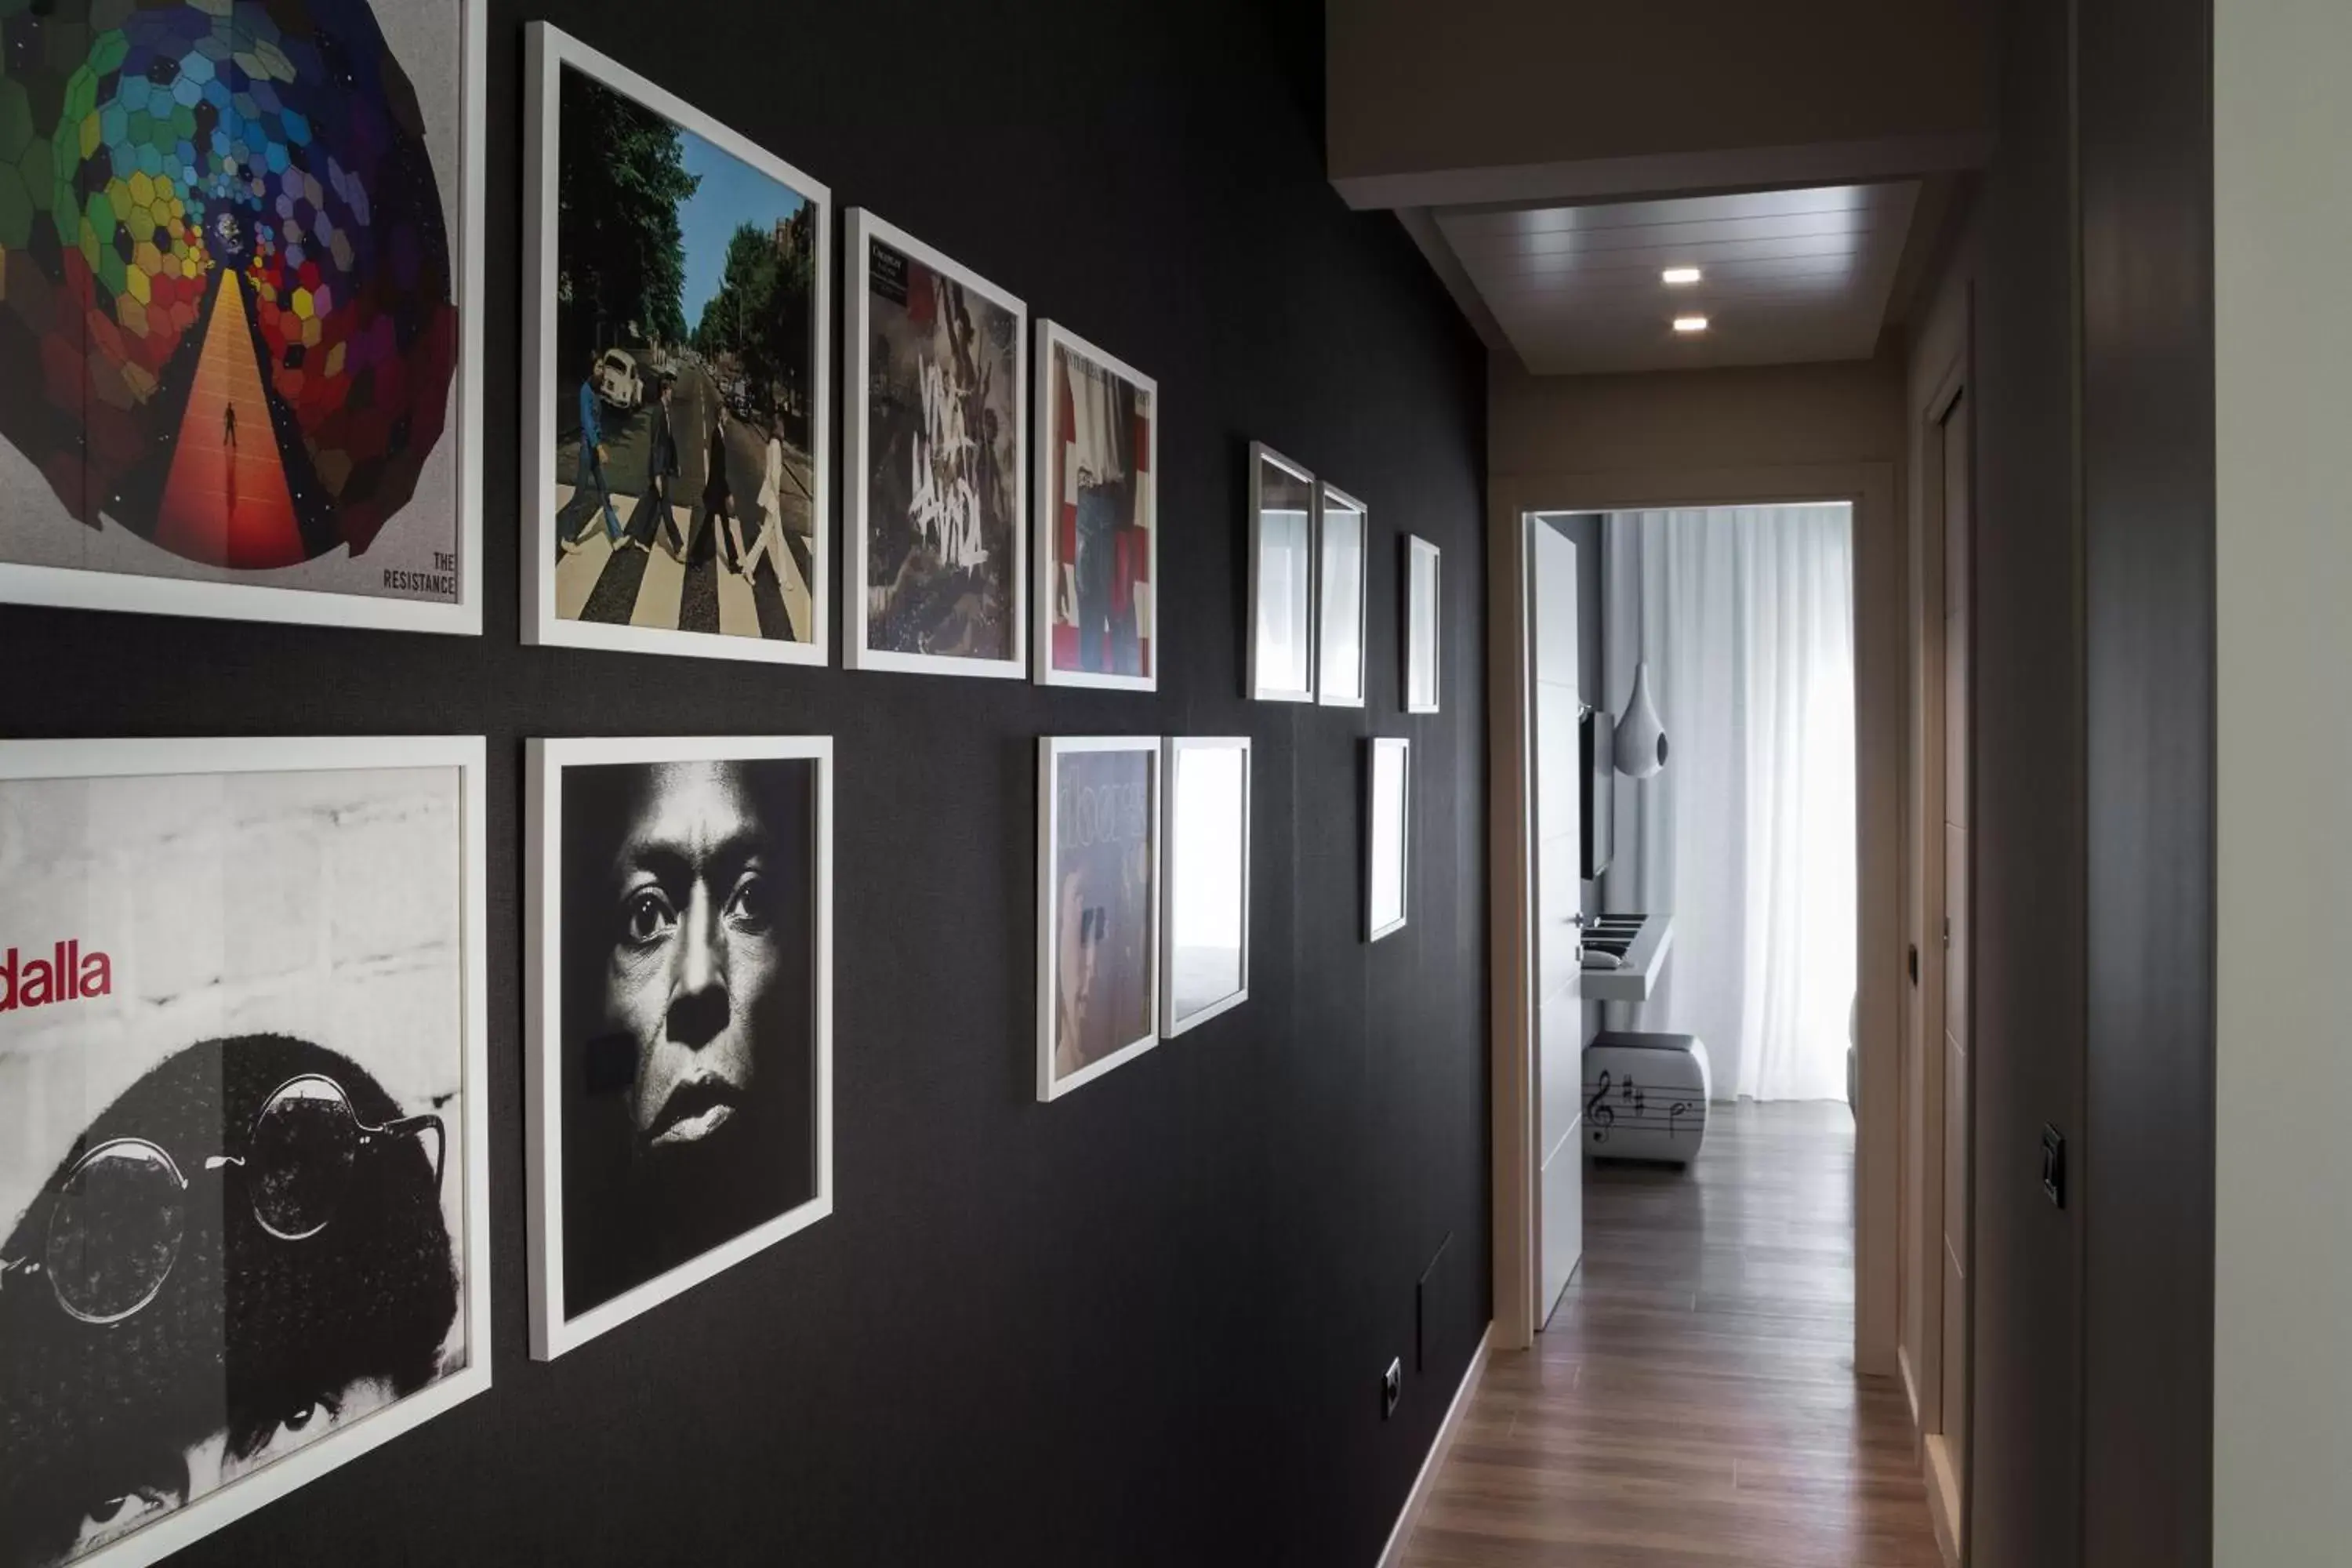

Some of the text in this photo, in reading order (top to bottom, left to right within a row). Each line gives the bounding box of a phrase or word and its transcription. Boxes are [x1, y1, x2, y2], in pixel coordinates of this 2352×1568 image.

[434, 551, 455, 572] THE
[383, 568, 455, 594] RESISTANCE
[0, 939, 112, 1013] dalla
